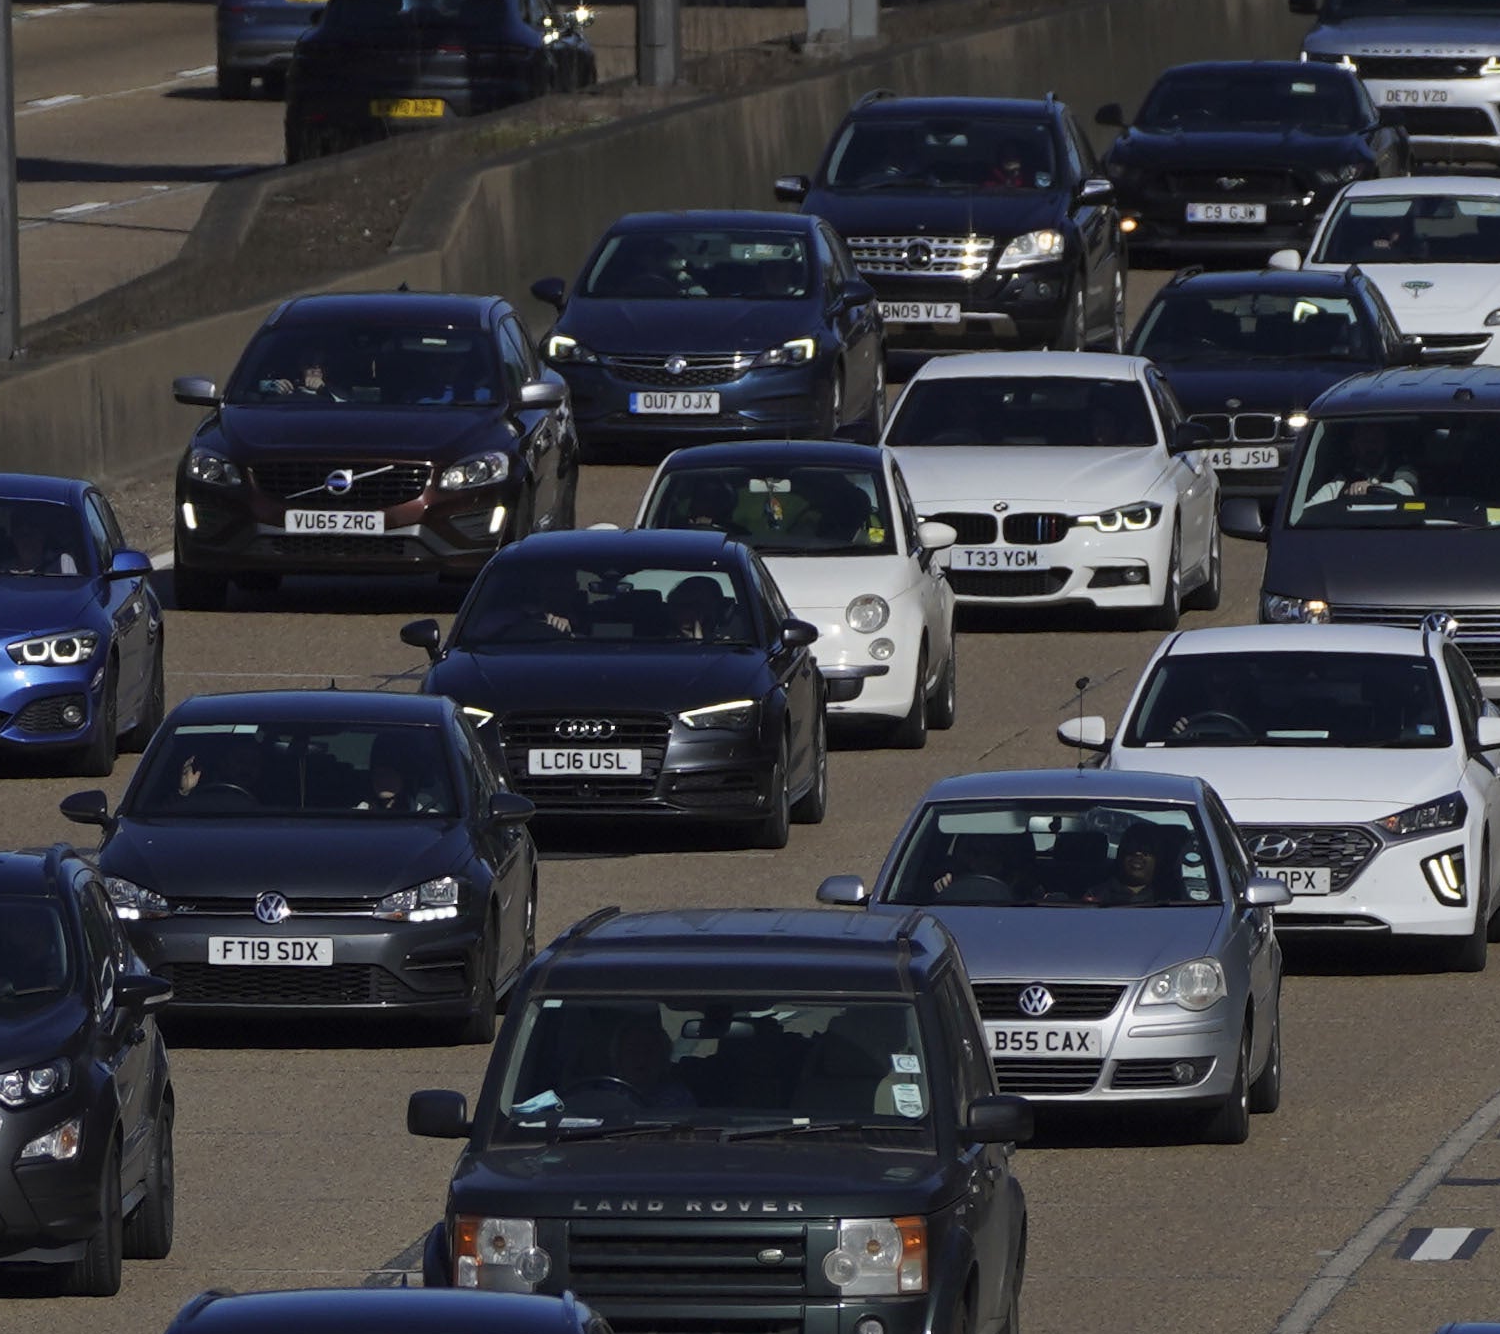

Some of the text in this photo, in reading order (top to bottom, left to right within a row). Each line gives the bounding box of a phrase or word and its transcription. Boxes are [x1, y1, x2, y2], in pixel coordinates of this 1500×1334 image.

[1204, 206, 1222, 218] C9
[881, 304, 954, 317] BN09 VLZ
[293, 513, 376, 530] VU65 ZRG
[964, 550, 1038, 567] T33 YGM
[541, 752, 628, 770] LC16 USL
[222, 941, 319, 960] FT19 SDX
[1045, 1030, 1091, 1050] CAX
[573, 1199, 805, 1213] LAND ROVER
